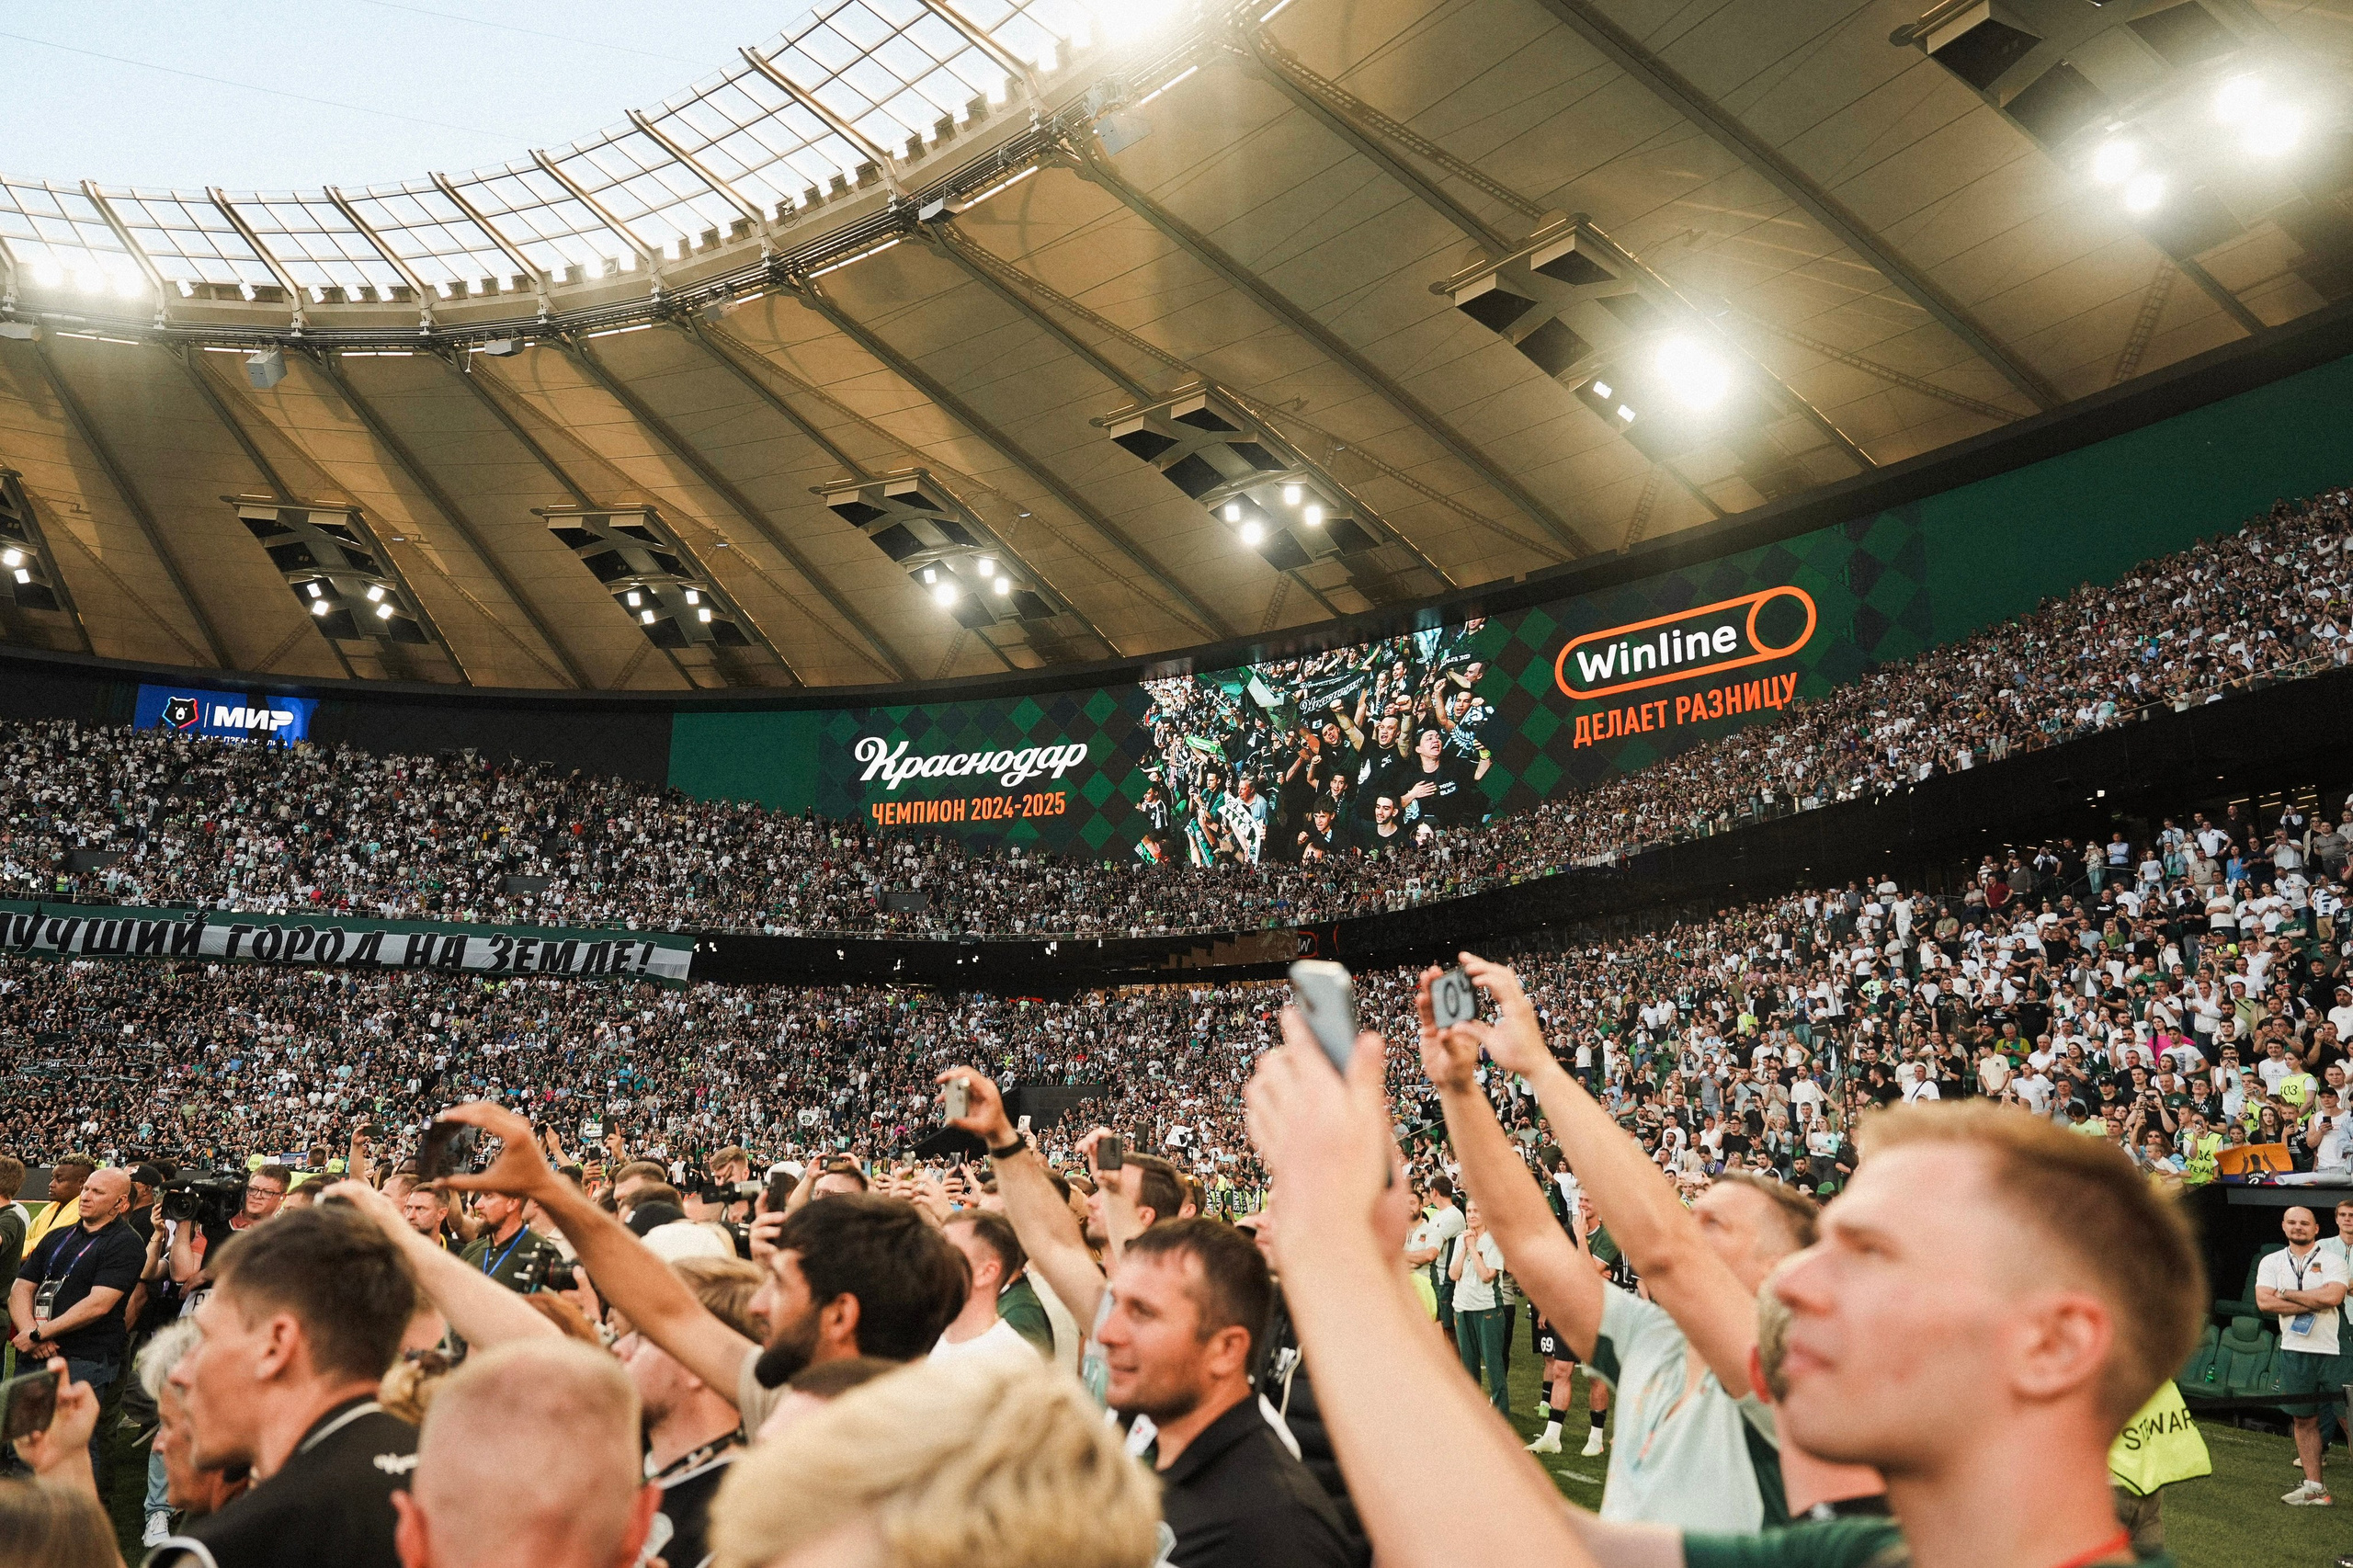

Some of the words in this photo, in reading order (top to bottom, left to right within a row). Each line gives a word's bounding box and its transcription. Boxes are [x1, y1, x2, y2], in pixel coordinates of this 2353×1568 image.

[1576, 625, 1737, 683] Winline
[213, 705, 294, 732] МИР
[1573, 699, 1668, 749] ДЕЛАЕТ
[1675, 672, 1798, 725] РАЗНИЦУ
[854, 736, 1088, 790] Краснодар
[871, 799, 966, 825] ЧЕМПИОН
[971, 791, 1066, 821] 2024-2025
[224, 923, 387, 968] ГОРОД
[403, 931, 470, 971] НА
[483, 932, 657, 976] ЗЕМЛЕ!
[1540, 1336, 1554, 1353] 69
